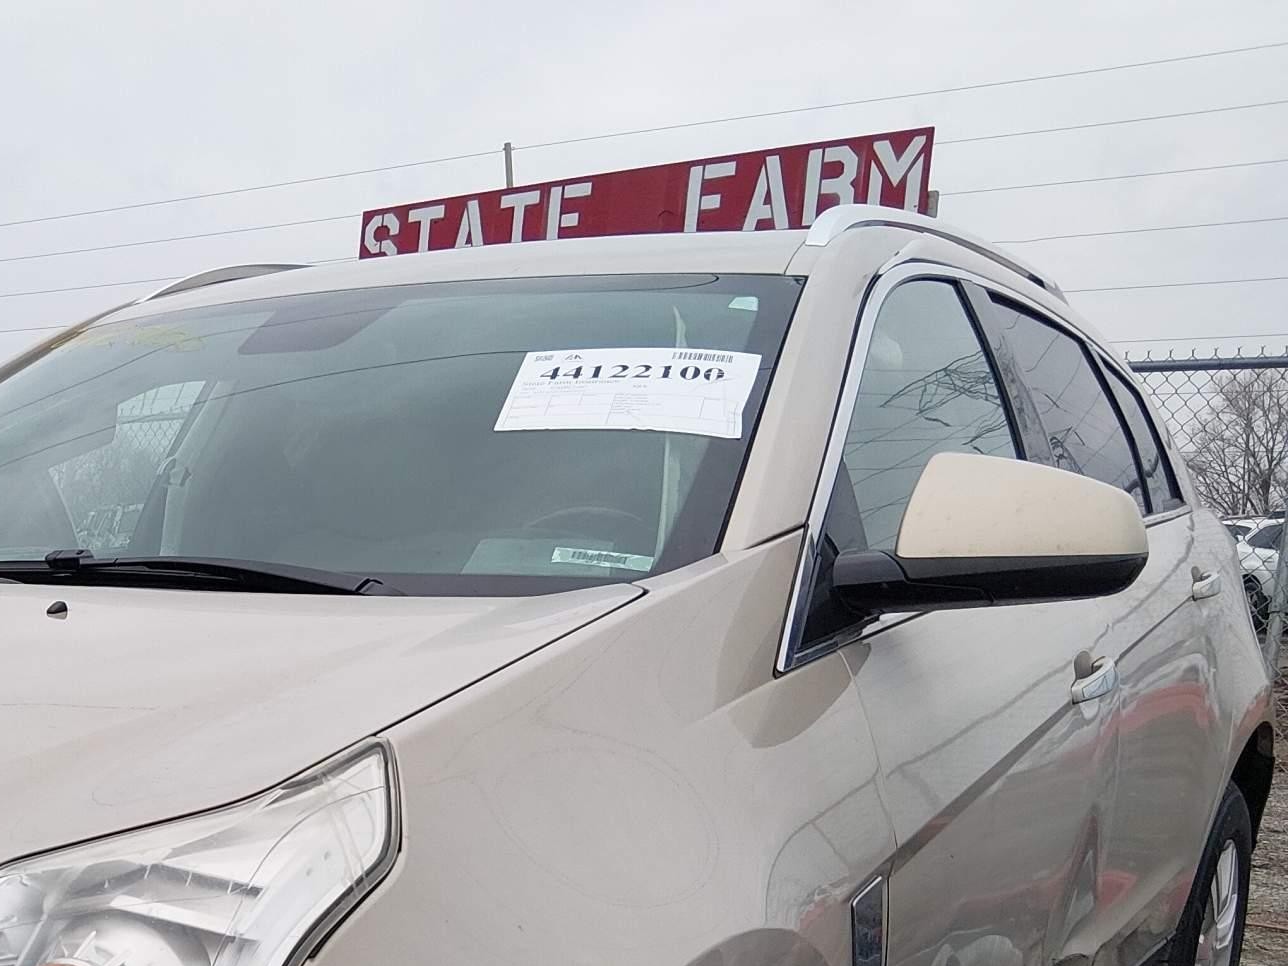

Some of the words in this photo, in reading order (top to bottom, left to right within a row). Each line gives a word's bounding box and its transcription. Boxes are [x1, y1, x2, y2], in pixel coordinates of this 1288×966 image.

[363, 182, 593, 257] STATE
[684, 134, 927, 233] FARM
[539, 364, 725, 382] 44122100
